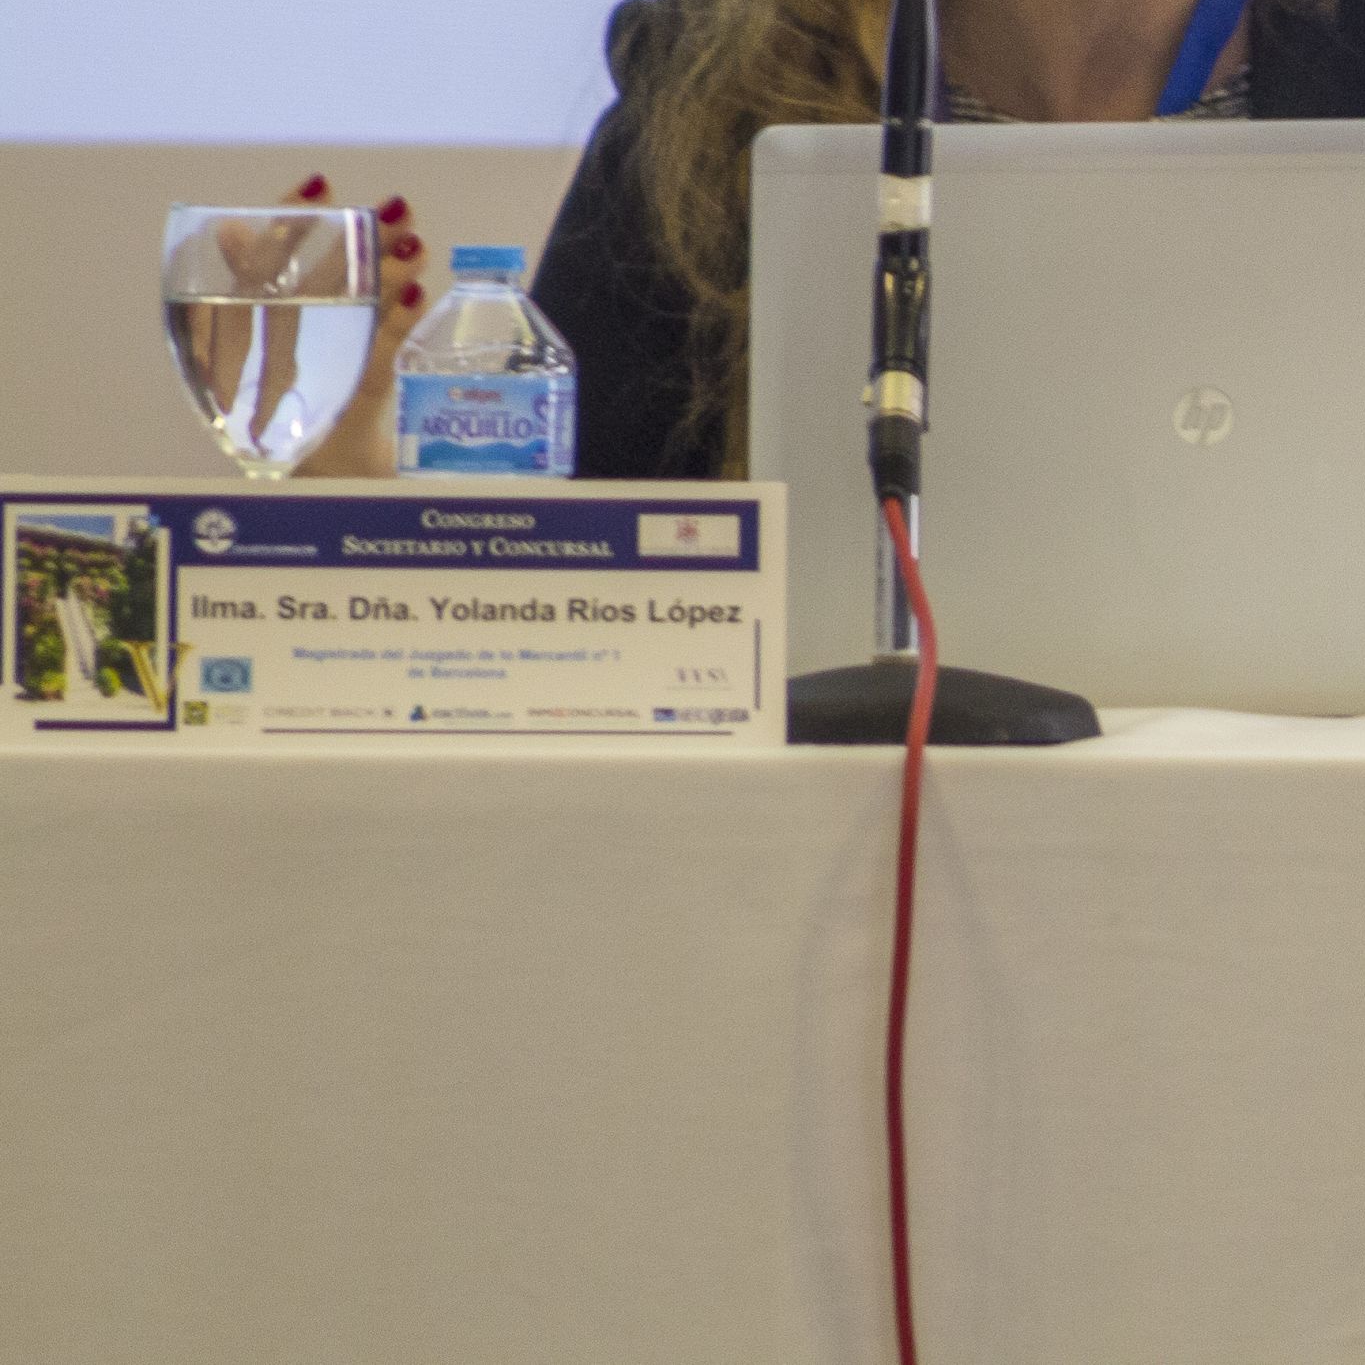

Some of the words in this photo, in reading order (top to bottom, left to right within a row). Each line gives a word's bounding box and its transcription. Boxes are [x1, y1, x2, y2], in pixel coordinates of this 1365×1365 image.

[191, 595, 265, 620] Ilma.
[277, 596, 337, 621] Sra.
[347, 597, 419, 621] Dña.
[429, 597, 556, 623] Yolanda
[647, 598, 743, 629] López
